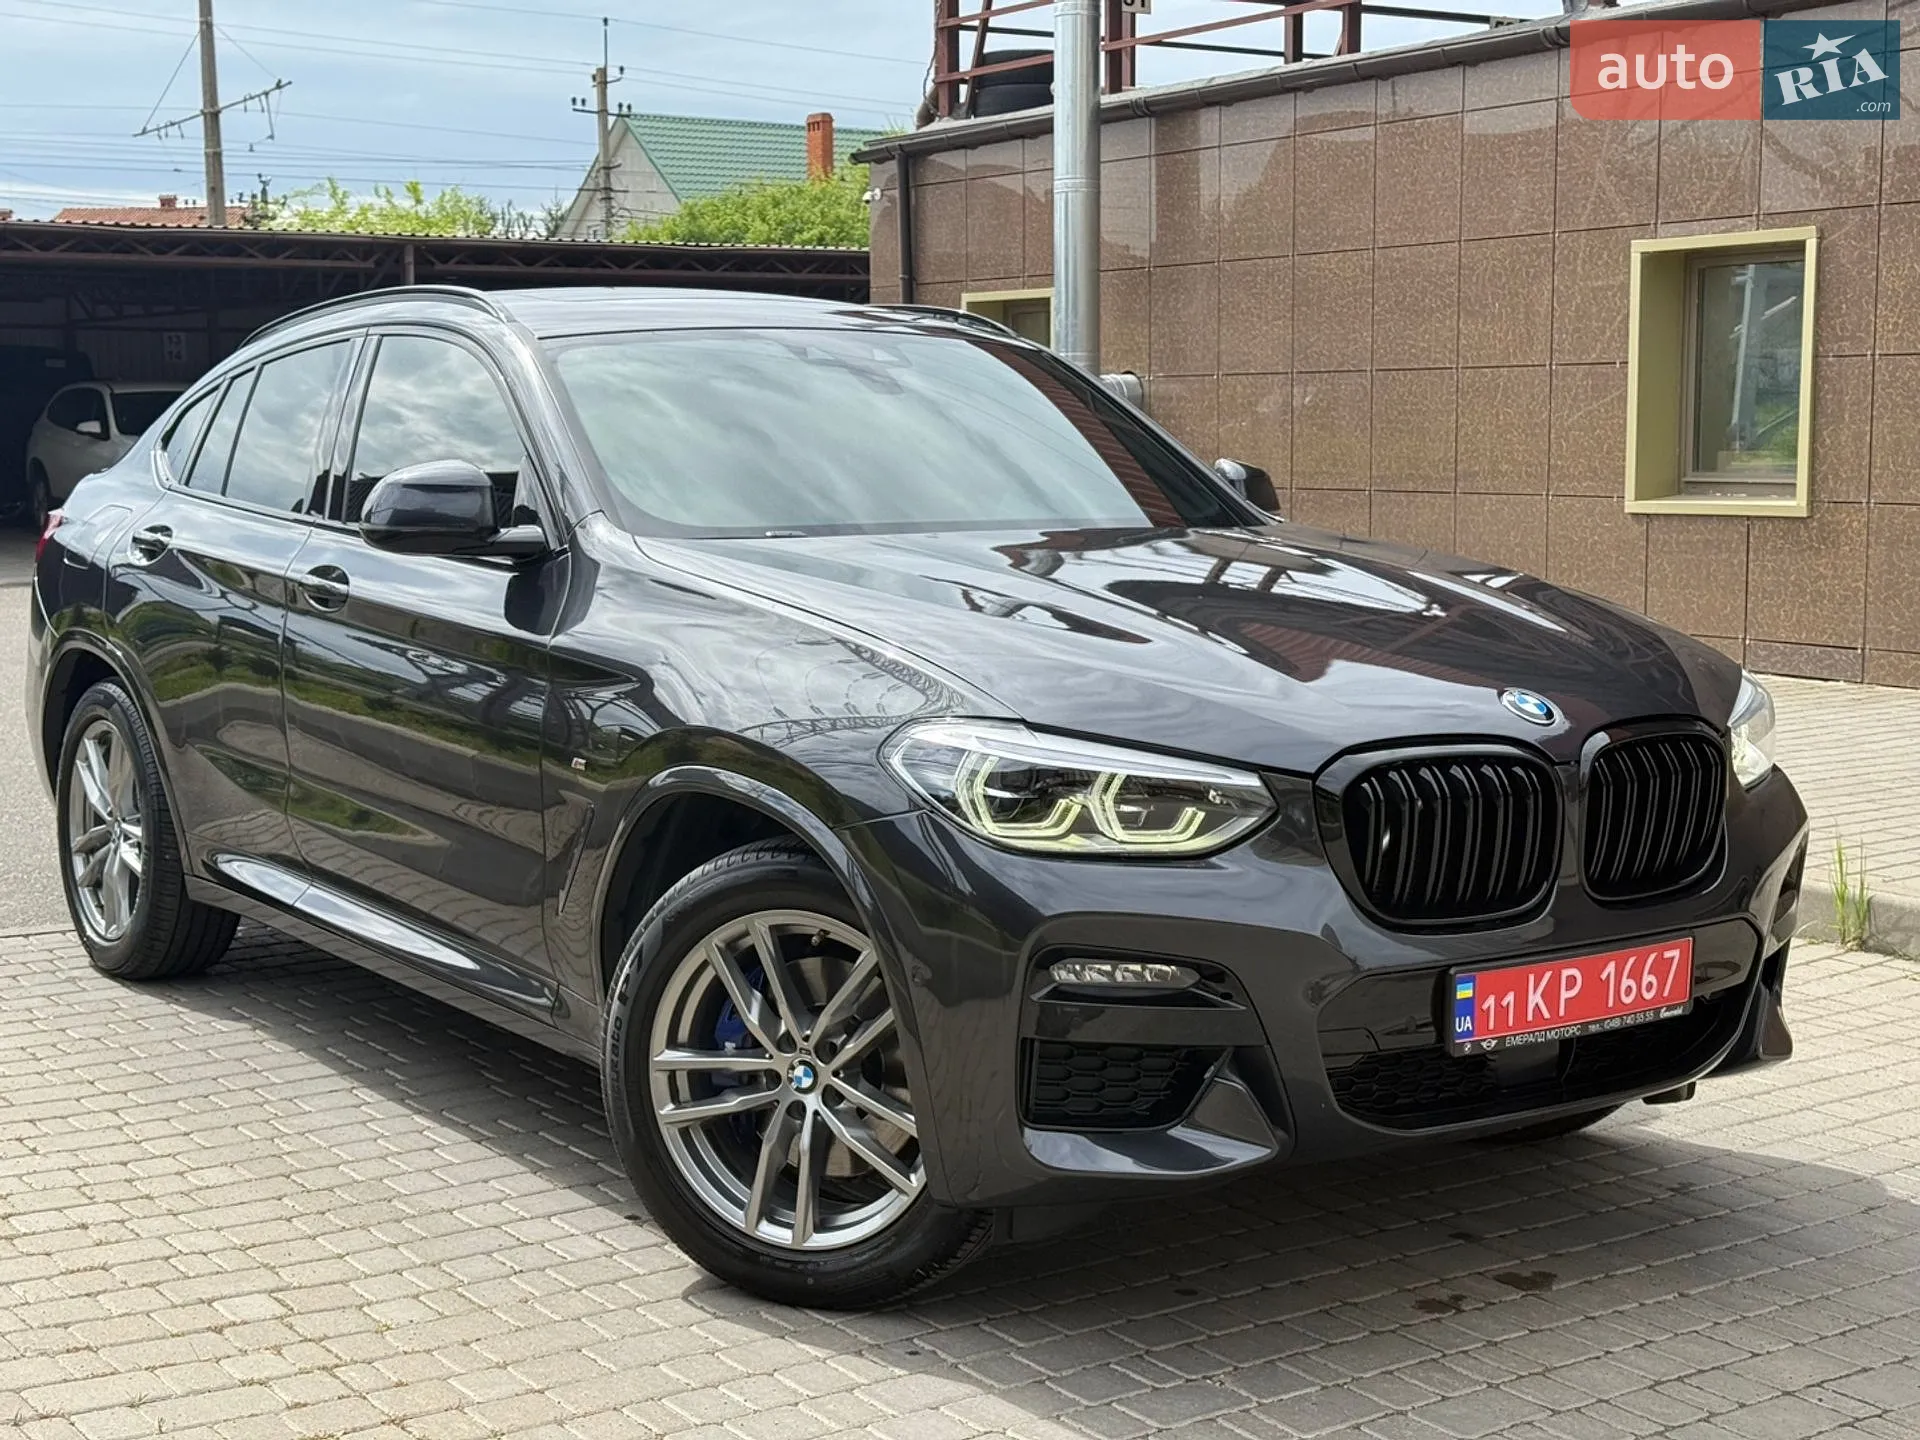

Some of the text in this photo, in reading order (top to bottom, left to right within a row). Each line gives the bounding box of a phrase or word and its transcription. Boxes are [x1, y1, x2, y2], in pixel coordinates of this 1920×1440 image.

[1481, 948, 1681, 1030] 11 KP 1667
[1455, 1015, 1473, 1033] UA
[1505, 1031, 1545, 1047] ЕМЕРАЛД
[1546, 1025, 1581, 1040] МОТОРС
